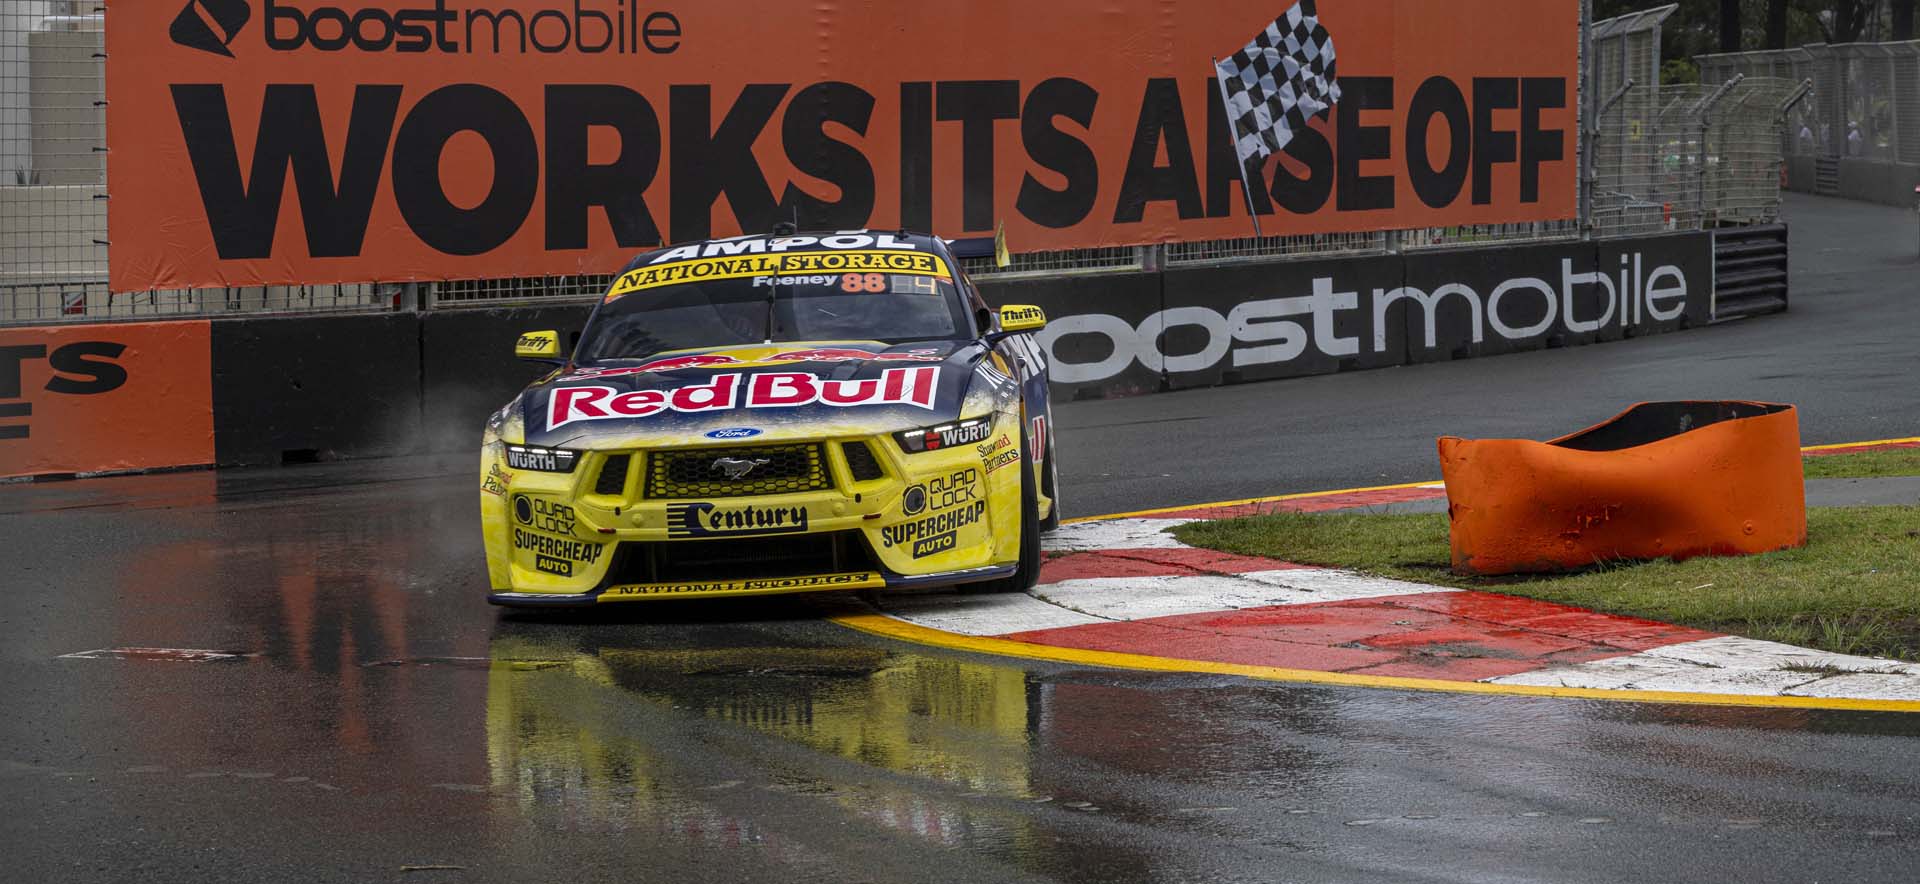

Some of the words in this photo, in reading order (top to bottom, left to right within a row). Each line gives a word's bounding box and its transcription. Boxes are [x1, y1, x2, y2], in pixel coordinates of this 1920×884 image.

[169, 80, 875, 260] WORKS
[899, 77, 1107, 234] ITS
[1405, 75, 1566, 208] OFF
[649, 234, 916, 265] AMPOL
[619, 257, 776, 290] NATIONAL
[785, 254, 932, 271] STORAGE
[752, 273, 838, 287] Feeney
[841, 272, 886, 293] 88
[1002, 307, 1043, 321] Thrifty
[546, 372, 741, 432] Red
[746, 366, 941, 411] Bull
[715, 428, 752, 438] Ford
[942, 421, 990, 446] WÜRTH
[508, 451, 556, 470] WÜRTH
[982, 448, 1019, 472] Partners
[930, 468, 976, 494] QUAD
[930, 484, 976, 510] LOCK
[535, 498, 575, 521] QUAD
[683, 502, 808, 538] Century
[536, 515, 577, 537] LOCK
[881, 500, 985, 548] SUPERCHEAP
[514, 528, 603, 564] SUPERCHEAP
[917, 535, 953, 555] AUTO
[538, 558, 569, 573] AUTO
[620, 582, 740, 595] NATIONAL
